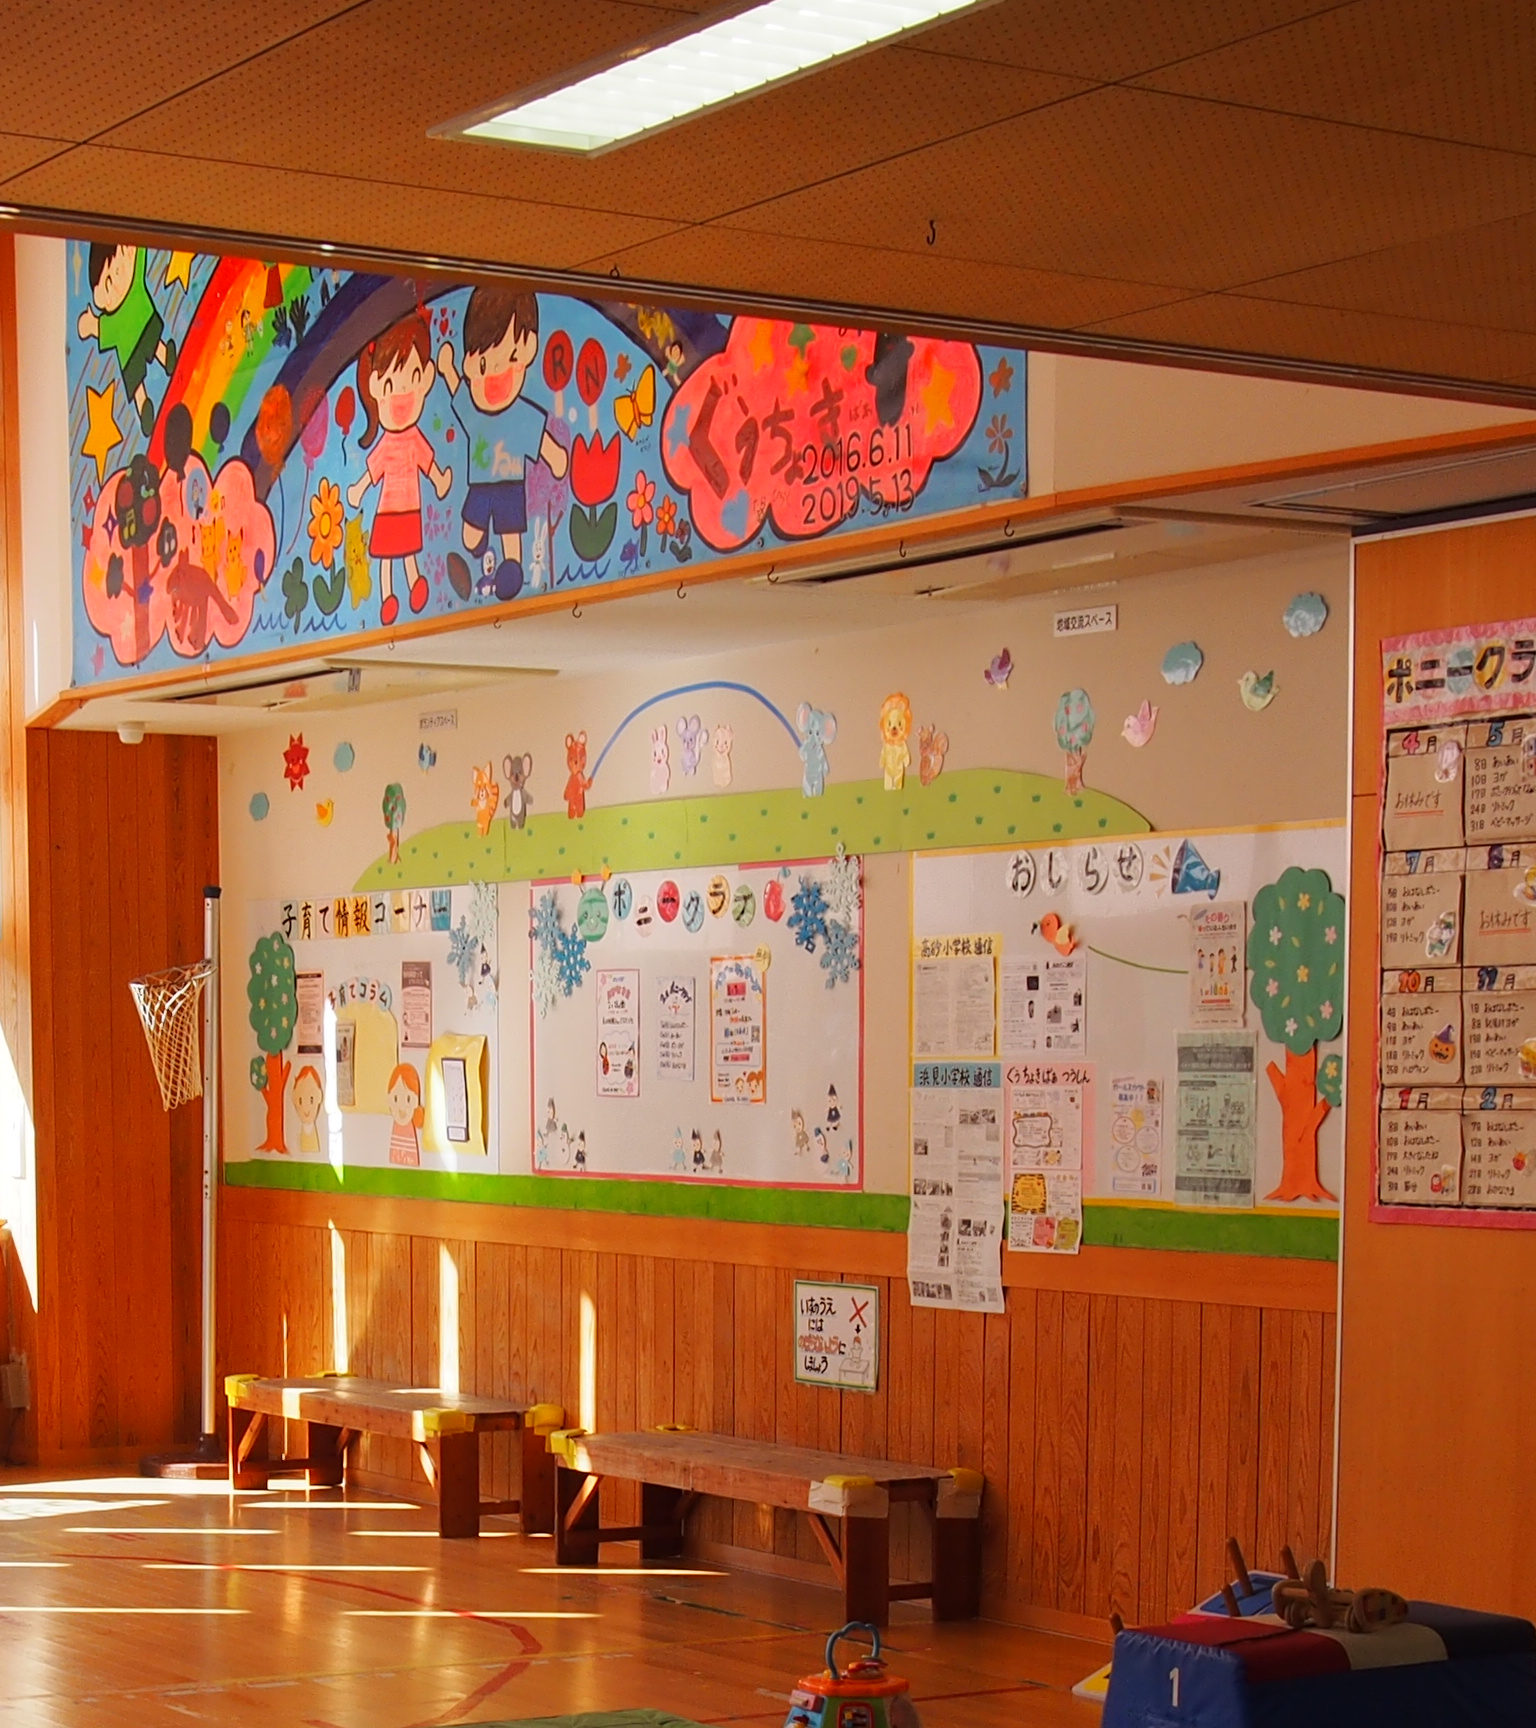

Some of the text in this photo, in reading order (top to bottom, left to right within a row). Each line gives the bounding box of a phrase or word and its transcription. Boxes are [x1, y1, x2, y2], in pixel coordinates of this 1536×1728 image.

[552, 344, 566, 383] R
[585, 356, 600, 395] N
[802, 424, 912, 485] 2016.6.11
[802, 468, 914, 524] 2019.5.13
[1056, 612, 1112, 632] 地域交流スペース
[1395, 789, 1443, 809] お休みです
[1012, 849, 1141, 893] おしらせ
[282, 894, 448, 940] 子育て情報コーナー
[613, 882, 753, 927] ポニークラブ
[1480, 910, 1532, 929] お休みです
[921, 937, 994, 958] 高砂小学校通信
[328, 982, 388, 1010] 子育てコラム
[1062, 1068, 1091, 1084] つうしん
[808, 1318, 824, 1332] には
[1169, 1666, 1181, 1708] 1
